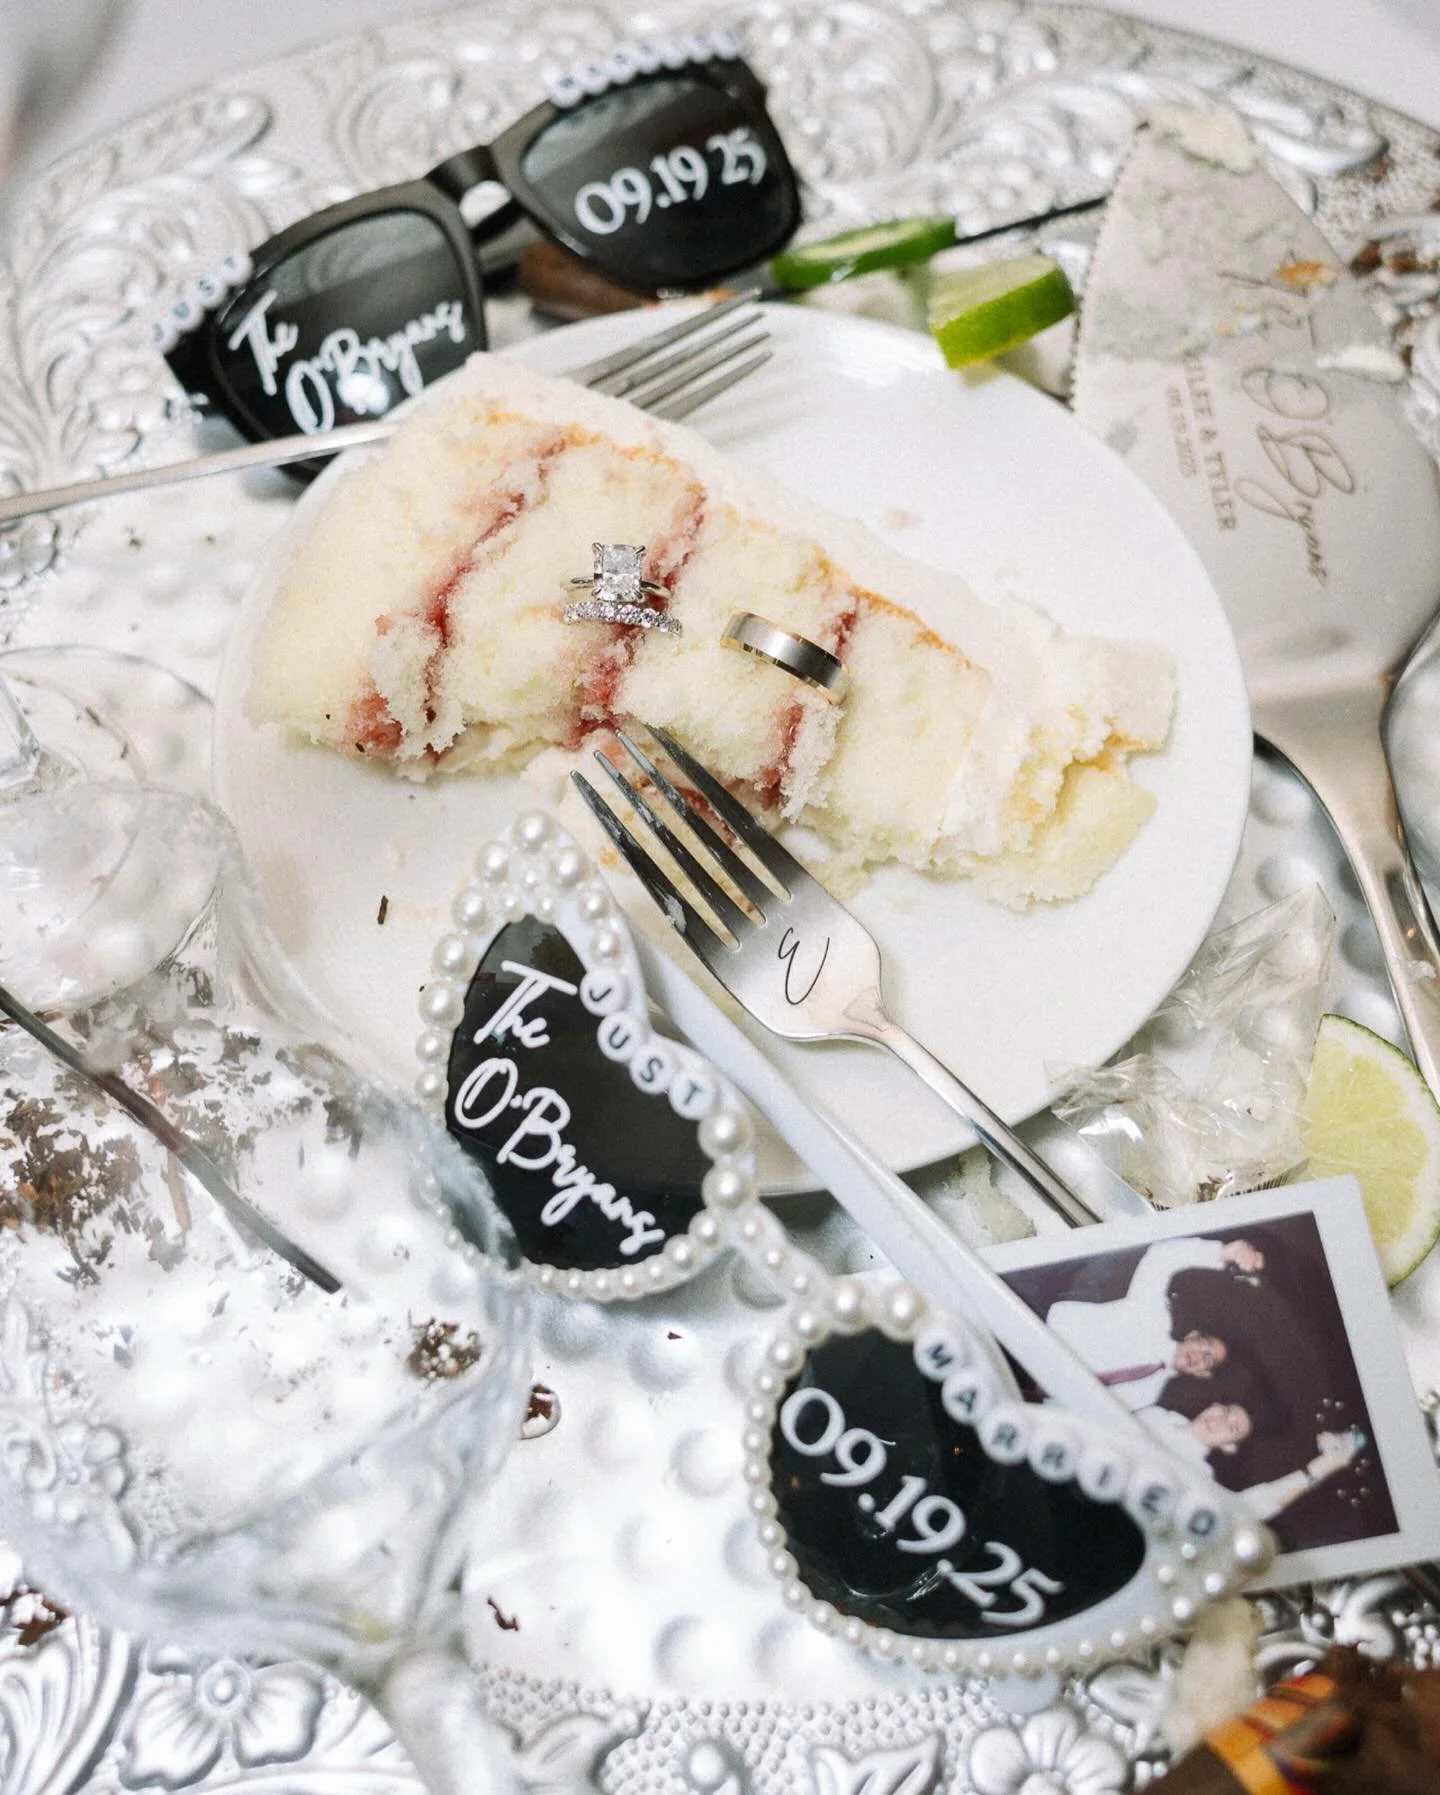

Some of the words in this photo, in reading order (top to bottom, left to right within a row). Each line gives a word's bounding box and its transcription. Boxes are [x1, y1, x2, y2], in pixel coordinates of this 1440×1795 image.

[228, 289, 299, 396] The
[1203, 450, 1237, 533] TYLER
[473, 960, 578, 1049] The
[586, 986, 704, 1105] JUST
[455, 1057, 666, 1256] O'Bryans
[926, 1342, 1216, 1538] MARRIED
[780, 1387, 1064, 1627] 09.19.25
